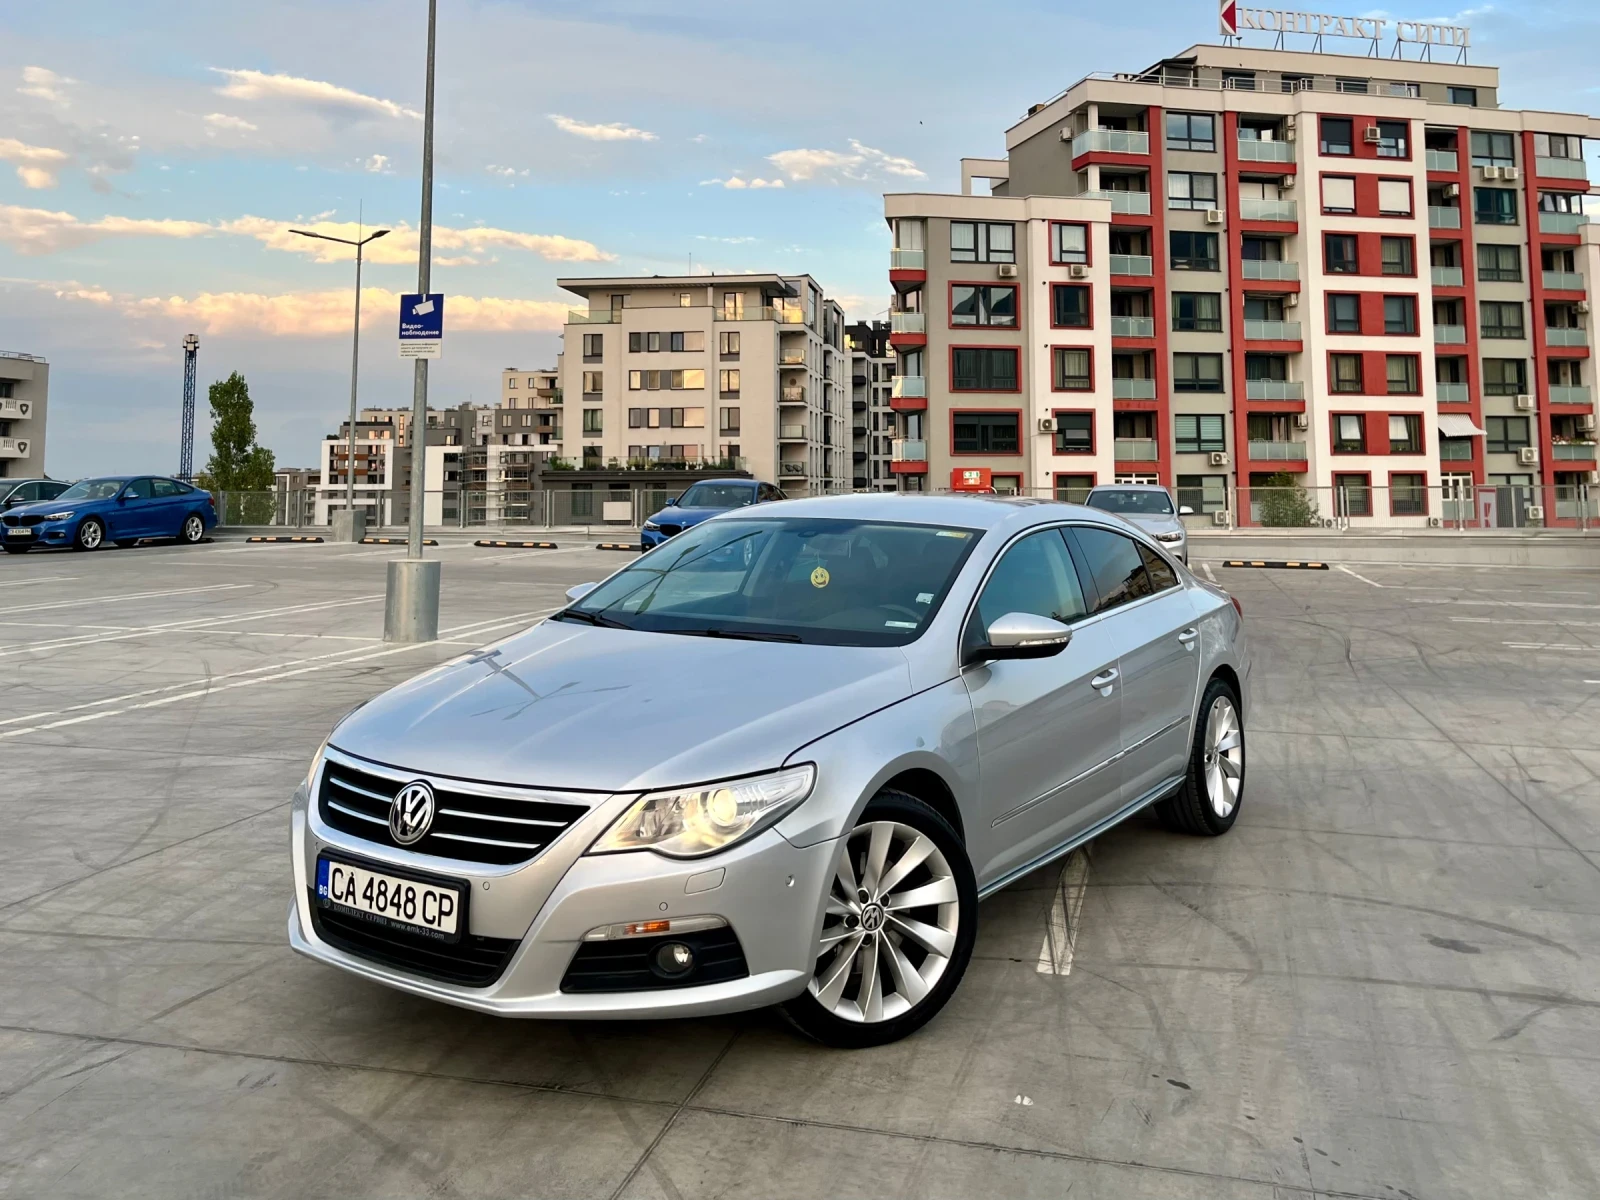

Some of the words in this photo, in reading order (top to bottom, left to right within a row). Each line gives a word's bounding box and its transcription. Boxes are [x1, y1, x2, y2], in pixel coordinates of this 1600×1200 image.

[1240, 8, 1386, 40] КОНТРАКТ
[1397, 21, 1471, 47] СИТИ
[318, 884, 328, 896] BG
[362, 877, 417, 920] 4848
[422, 890, 454, 927] CP
[390, 921, 445, 940] www.emk-33.com
